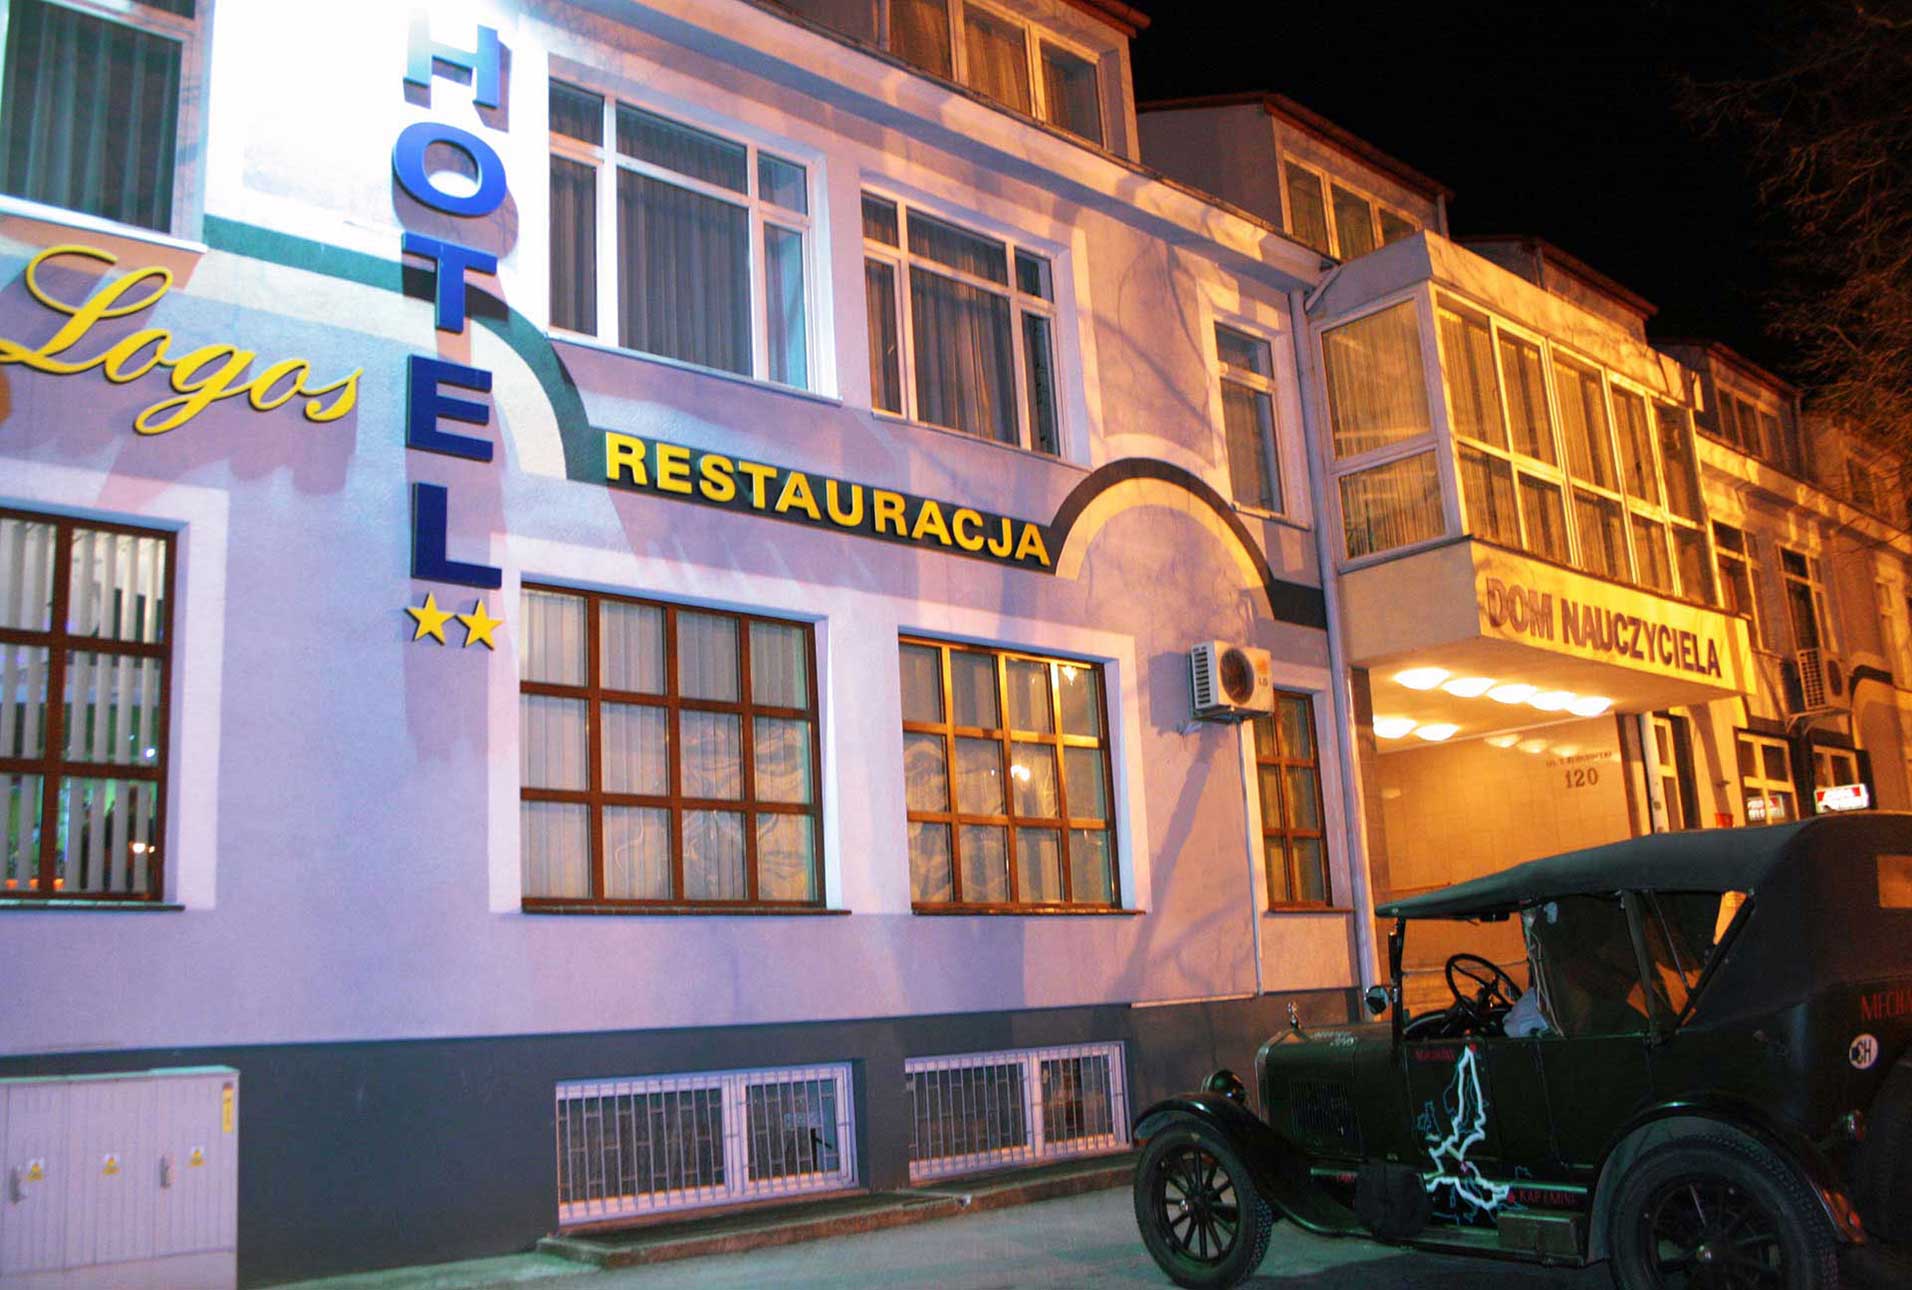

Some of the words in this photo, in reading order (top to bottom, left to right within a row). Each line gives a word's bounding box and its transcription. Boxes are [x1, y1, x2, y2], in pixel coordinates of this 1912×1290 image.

[0, 244, 363, 436] Logos
[392, 8, 507, 589] HOTEL
[605, 430, 1052, 567] RESTAURACJA
[1485, 576, 1555, 641] DOM
[1560, 597, 1723, 679] NAUCZYCIELA
[1565, 767, 1599, 788] 120
